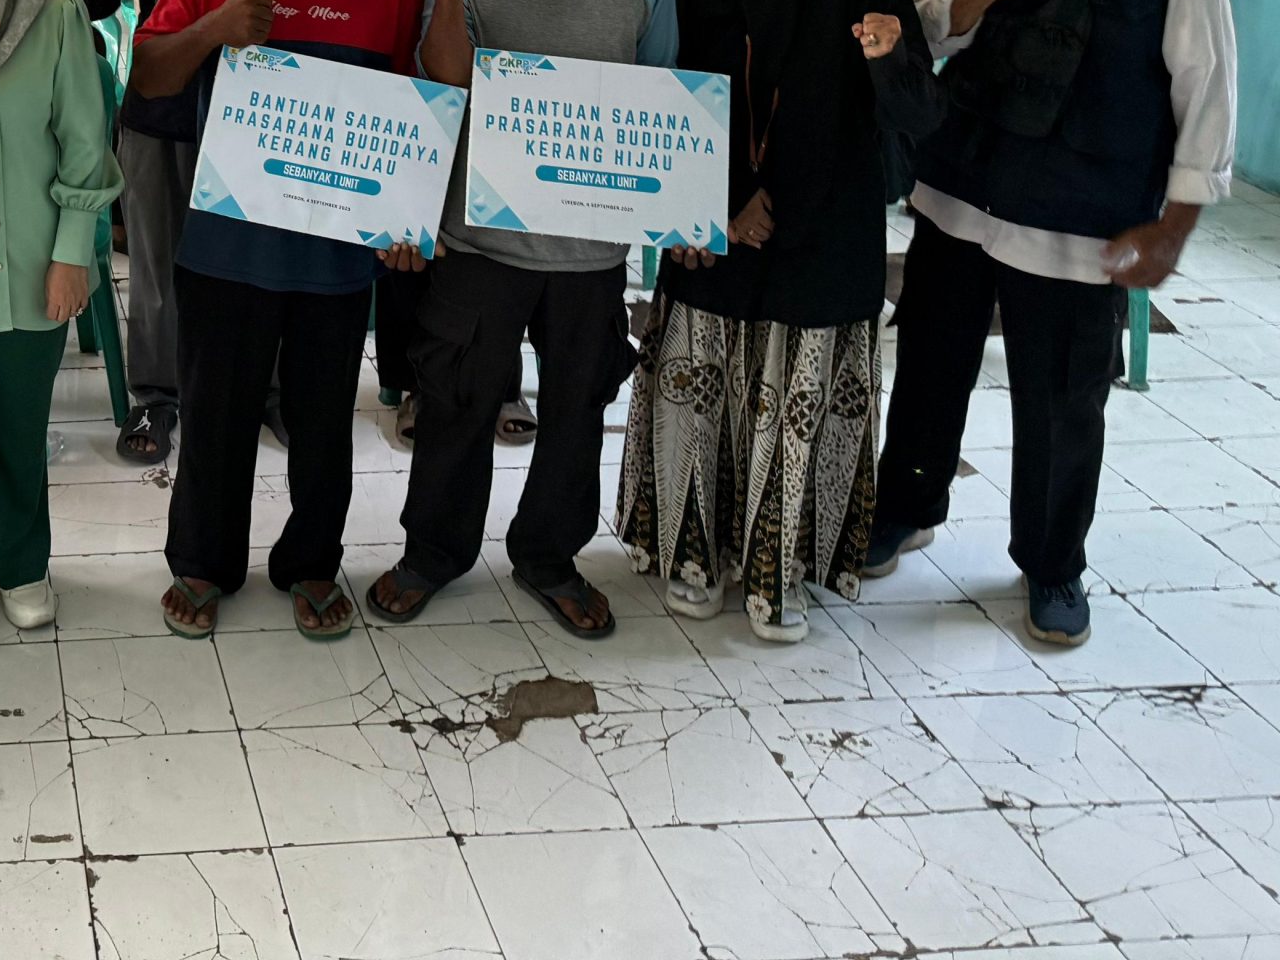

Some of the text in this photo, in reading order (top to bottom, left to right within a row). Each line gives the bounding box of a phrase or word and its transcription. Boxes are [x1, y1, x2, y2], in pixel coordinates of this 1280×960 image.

[271, 0, 351, 21] leep More
[249, 91, 420, 141] BANTUAN SARANA
[510, 96, 692, 132] BANTUAN SARANA
[222, 106, 439, 165] PRASARANA BUDIDAYA
[485, 114, 715, 155] PRASARANA BUDIDAYA
[257, 132, 397, 176] KERANG HIJAU
[525, 139, 673, 172] KERANG HIJAU
[283, 163, 360, 190] SEBANYAK 1 UNIT
[557, 169, 639, 189] SEBANYAK 1 UNIT
[310, 199, 338, 209] SEPTEMBER
[590, 203, 620, 211] SEPTEMBER
